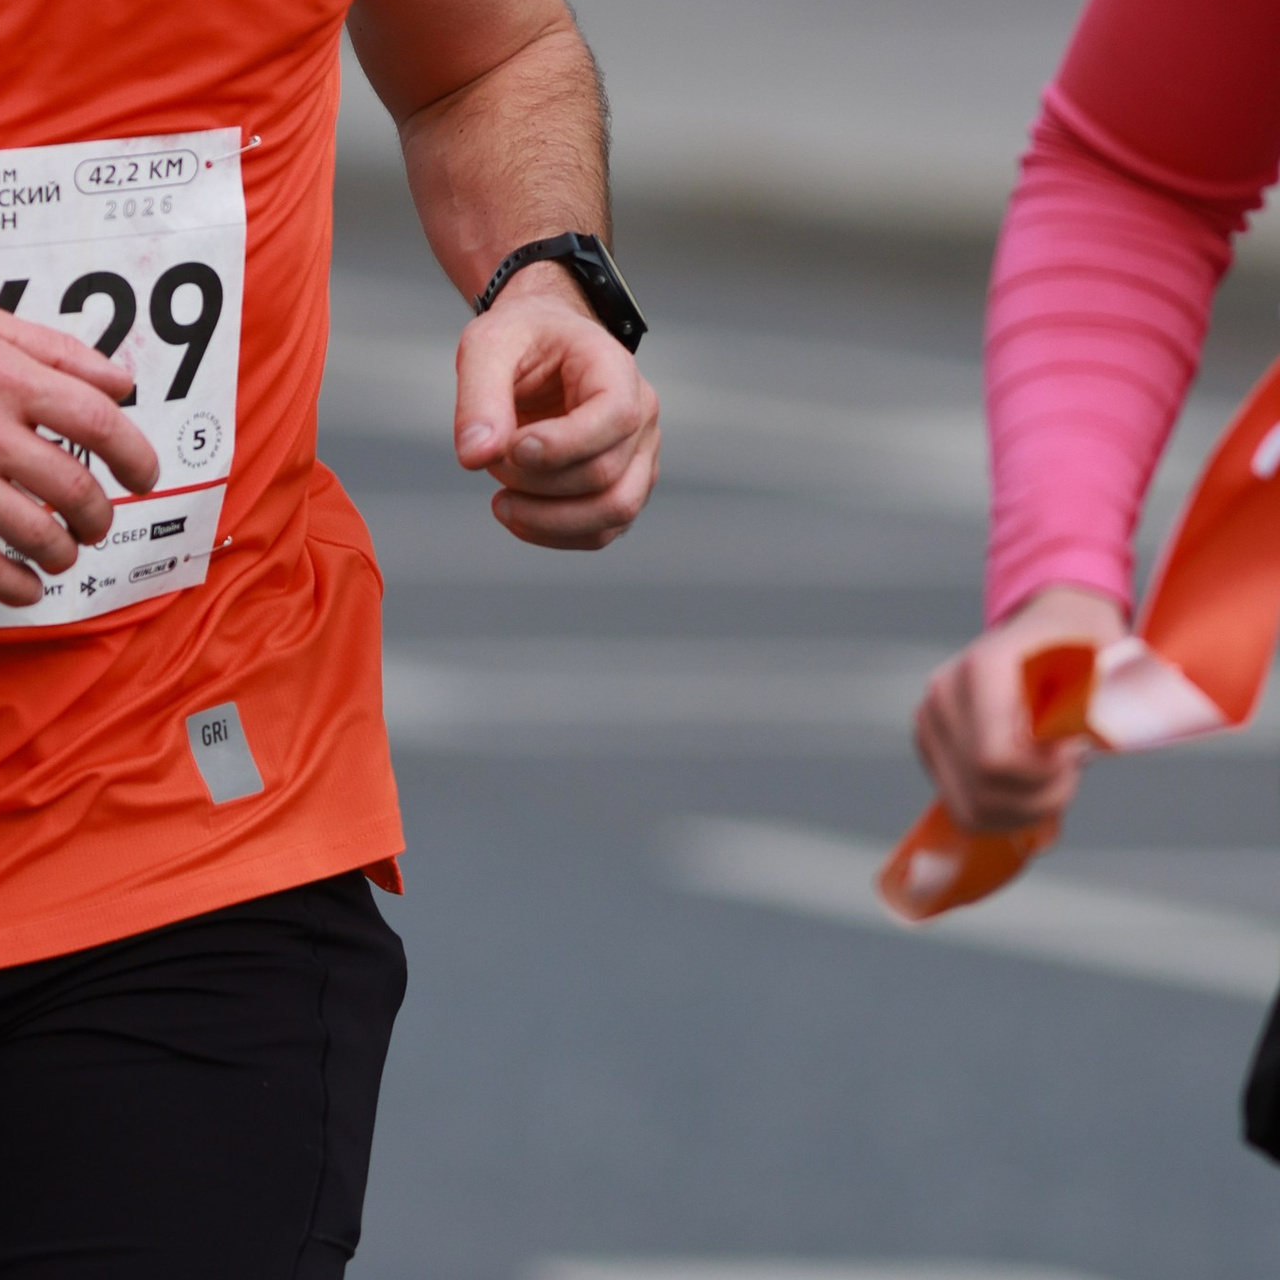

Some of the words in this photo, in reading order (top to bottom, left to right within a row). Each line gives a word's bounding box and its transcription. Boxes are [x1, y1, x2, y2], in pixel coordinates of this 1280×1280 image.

[88, 162, 139, 186] 42,2
[103, 195, 173, 221] 2026
[192, 428, 207, 451] 5
[111, 527, 148, 545] СБЕР
[132, 561, 167, 580] WINLINE
